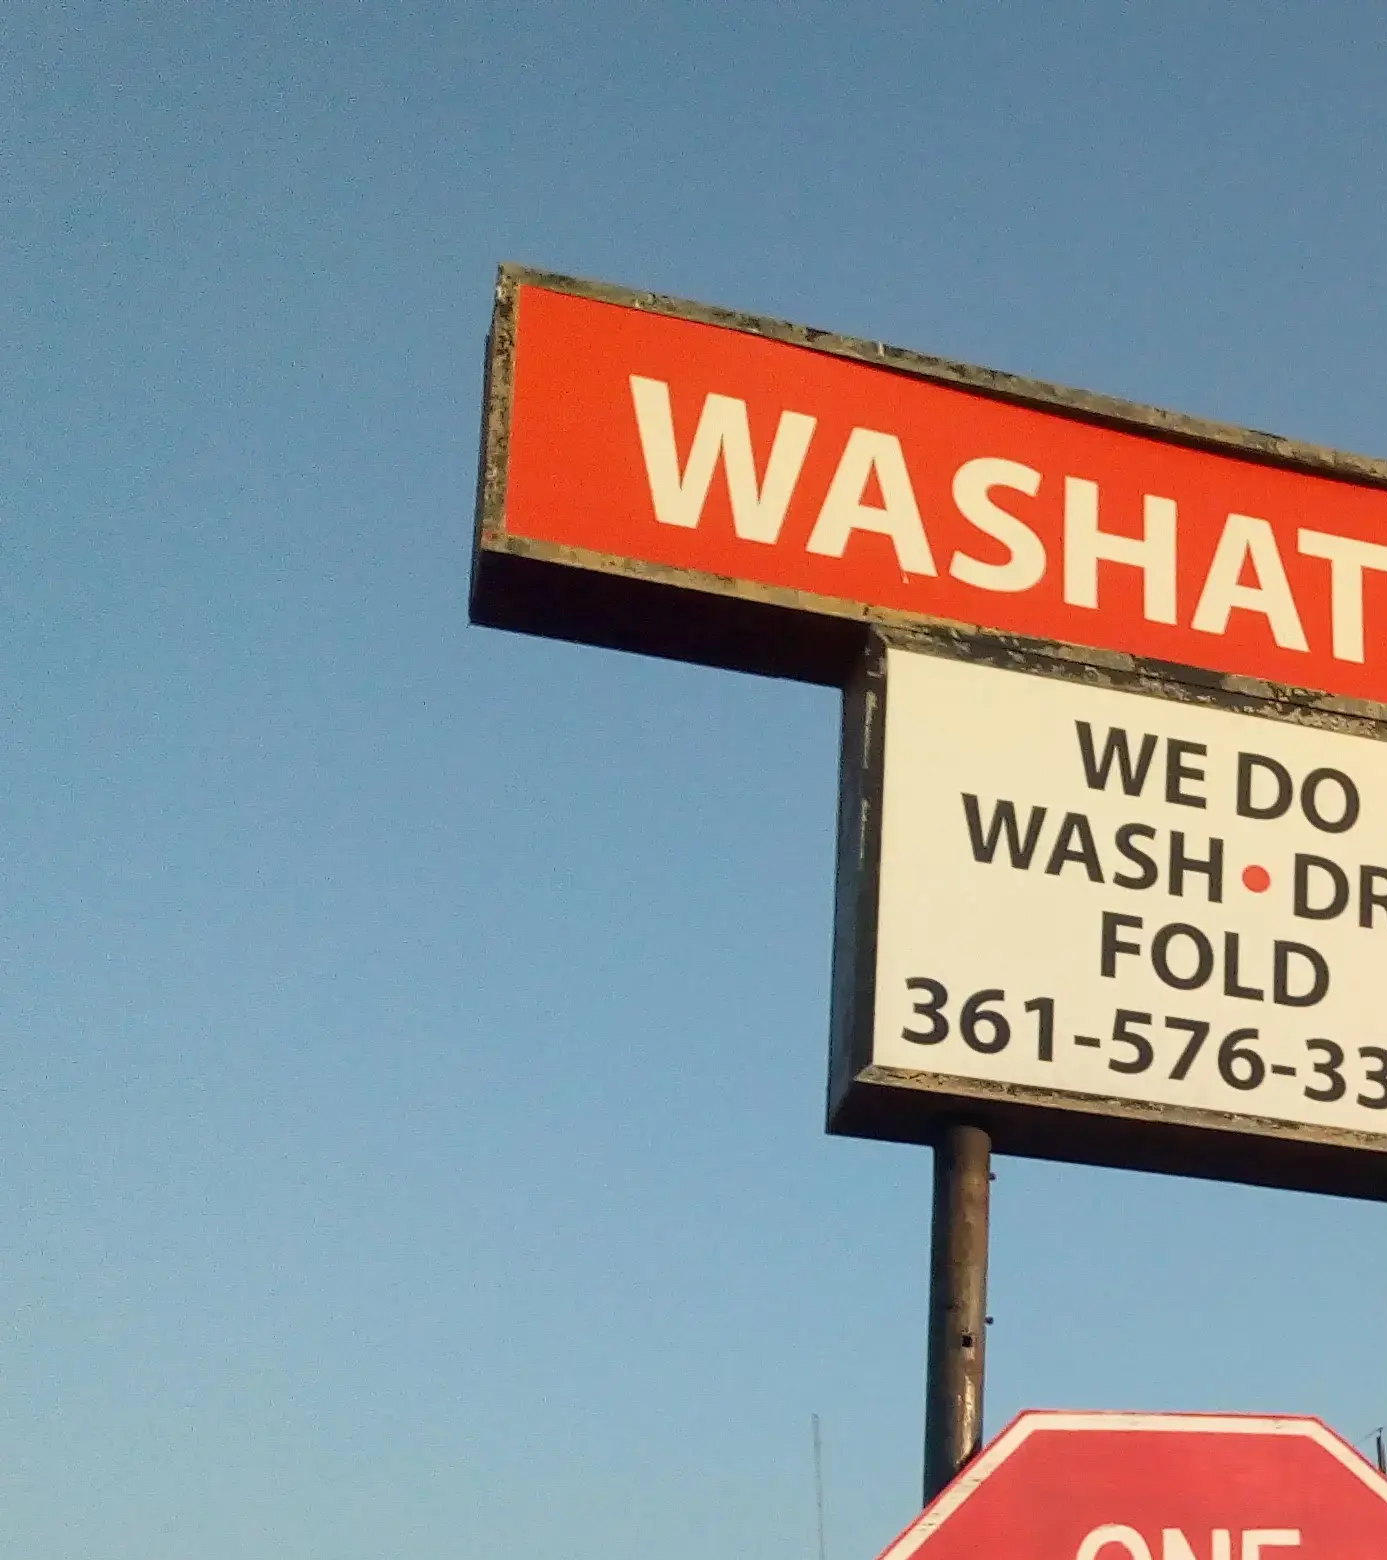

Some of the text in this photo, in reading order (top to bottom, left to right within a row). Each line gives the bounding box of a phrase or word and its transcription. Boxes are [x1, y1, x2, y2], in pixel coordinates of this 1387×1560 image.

[1075, 720, 1361, 835] WE DO
[961, 792, 1225, 905] WASH
[1100, 910, 1330, 1008] FOLD
